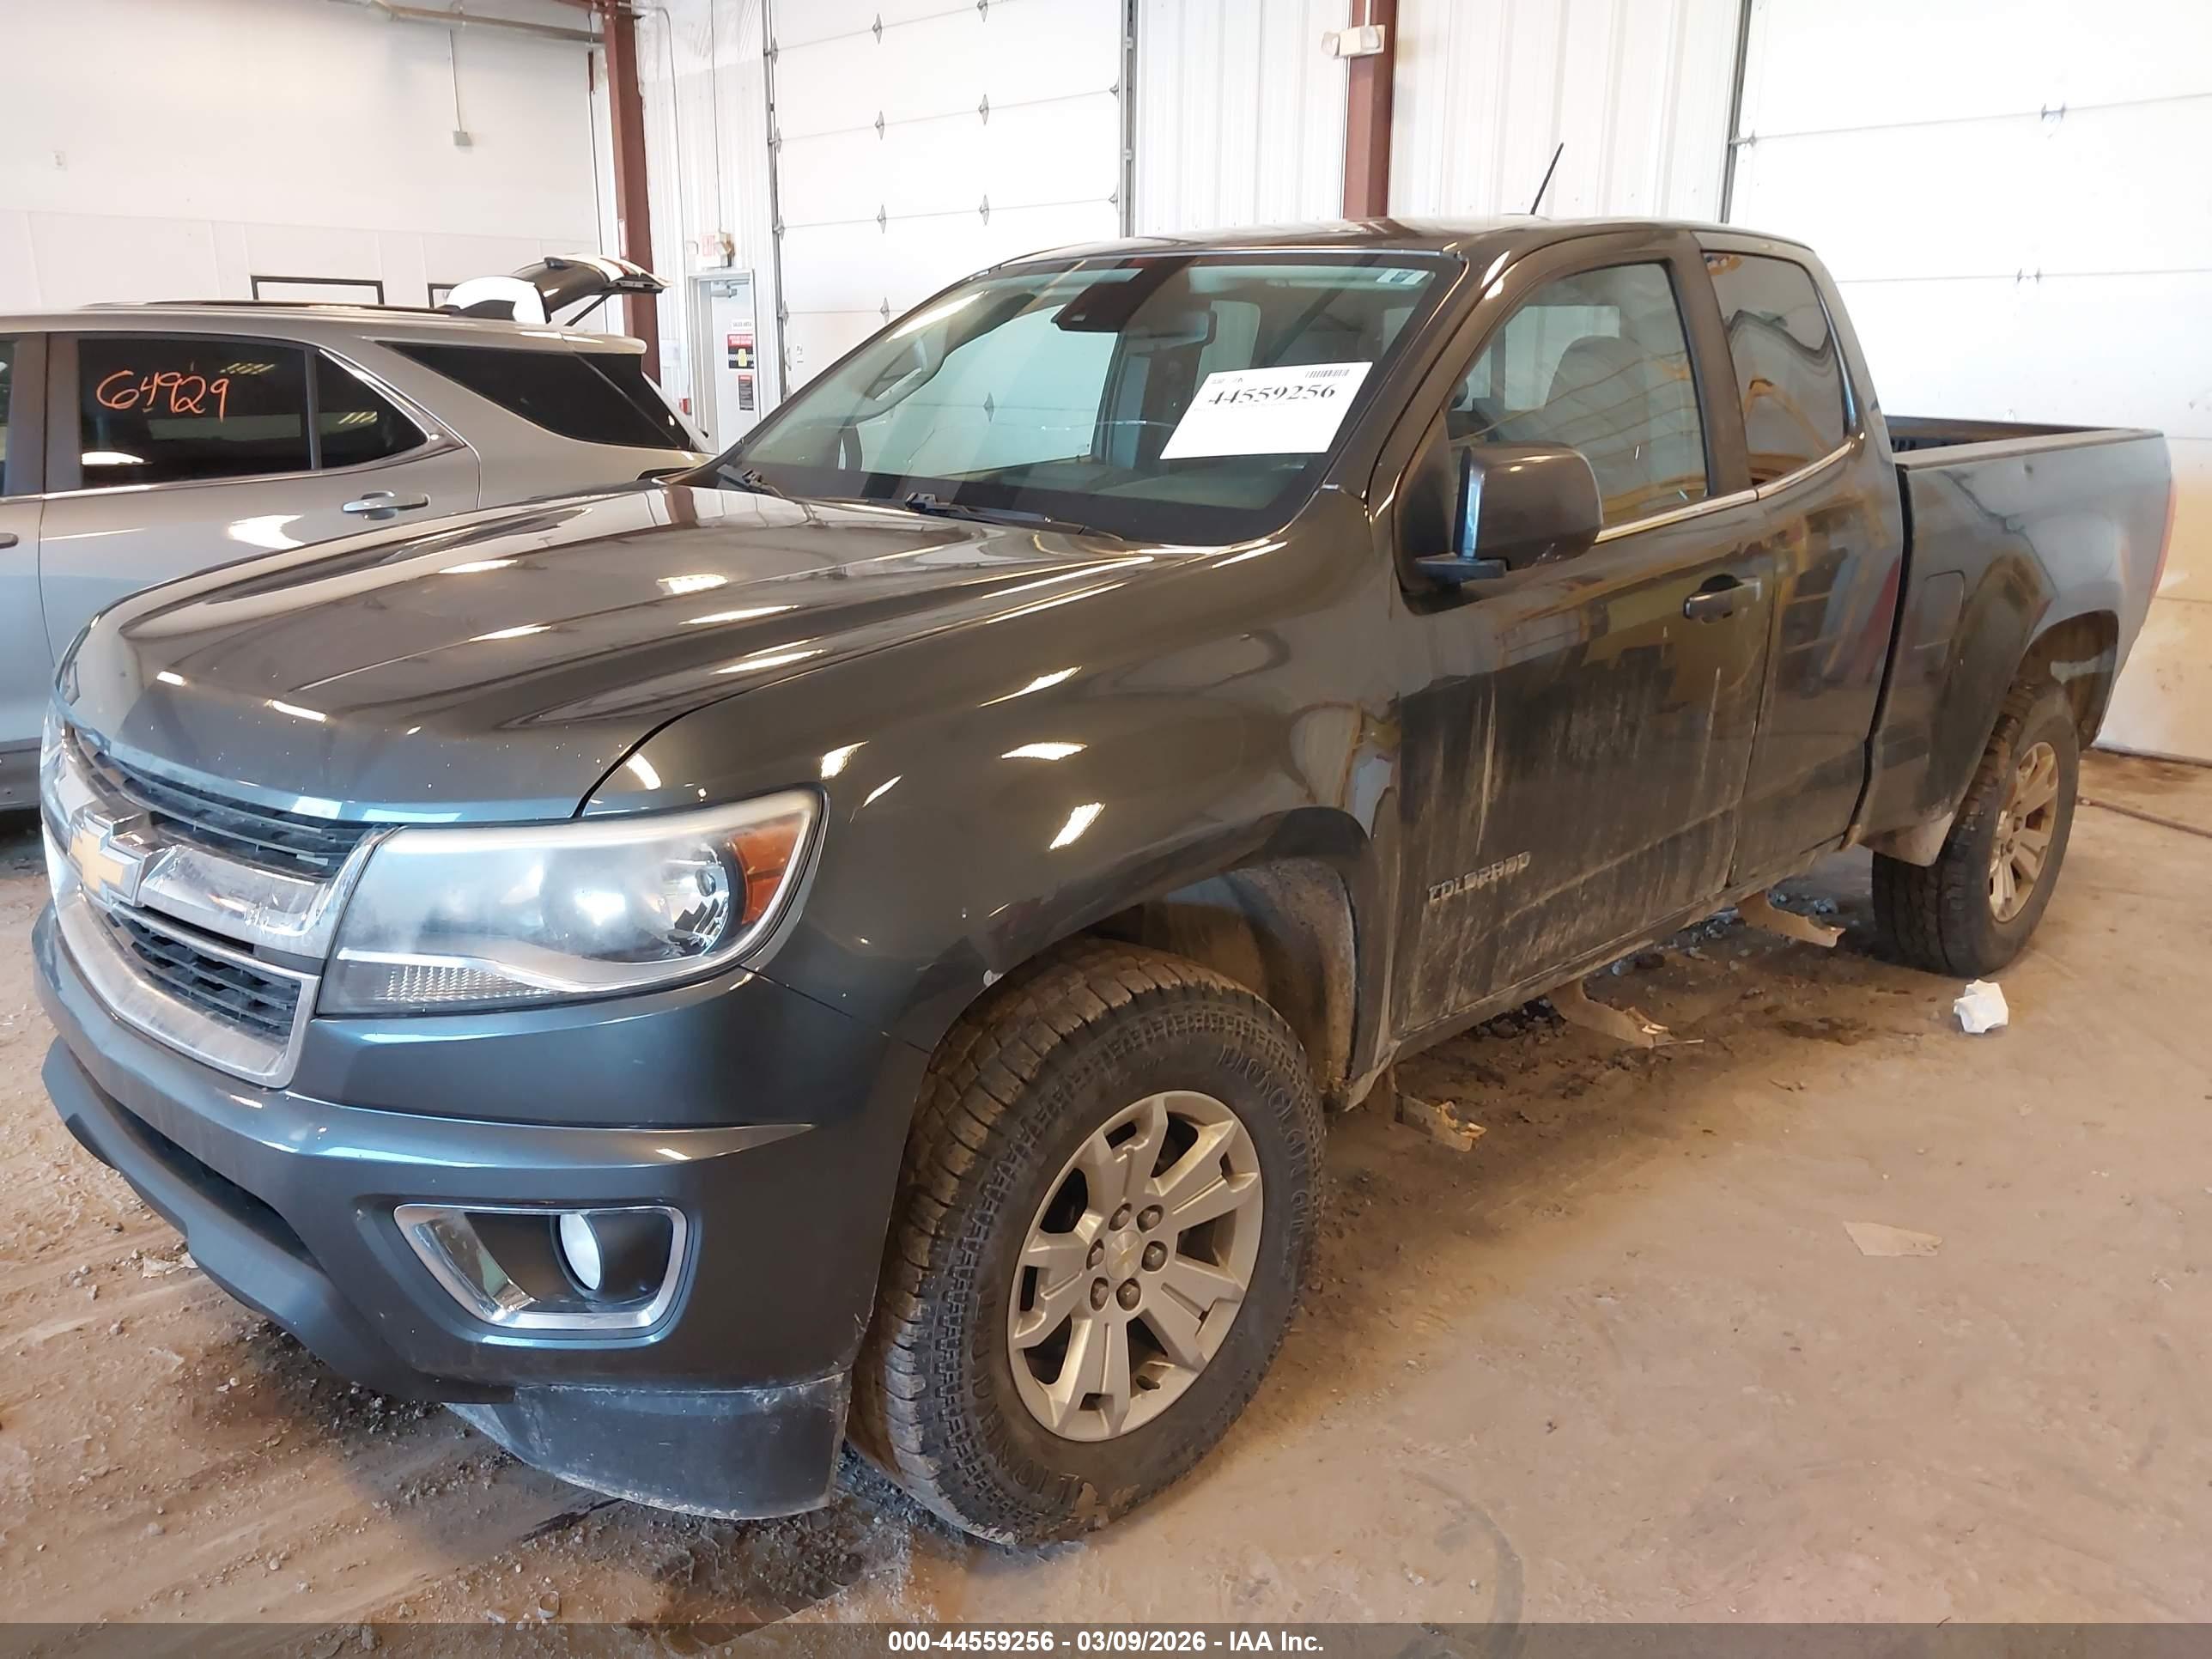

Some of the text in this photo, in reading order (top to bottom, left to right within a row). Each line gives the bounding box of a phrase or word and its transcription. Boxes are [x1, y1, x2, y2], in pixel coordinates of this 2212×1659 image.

[95, 369, 230, 422] 64929
[1208, 384, 1337, 405] 44559256
[1428, 851, 1531, 906] COLORADO
